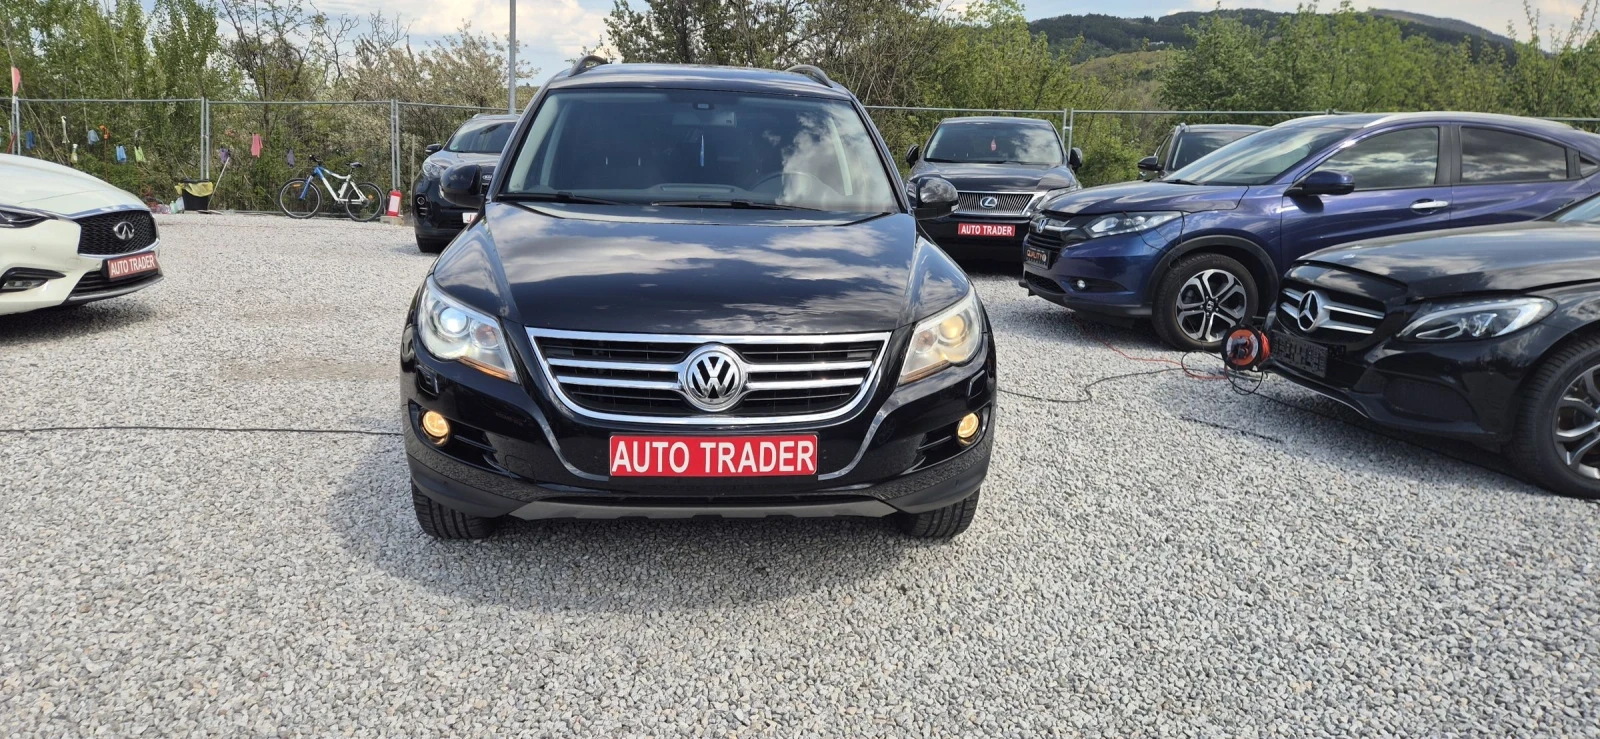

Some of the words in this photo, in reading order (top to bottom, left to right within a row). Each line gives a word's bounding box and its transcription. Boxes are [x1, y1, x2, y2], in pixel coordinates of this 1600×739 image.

[961, 225, 981, 235] AUTO
[983, 225, 1012, 236] TRADER
[1027, 249, 1042, 260] QUALITY
[110, 260, 129, 275] AUTO
[129, 255, 156, 271] TRADER
[611, 441, 690, 473] AUTO
[700, 440, 814, 473] TRADER
